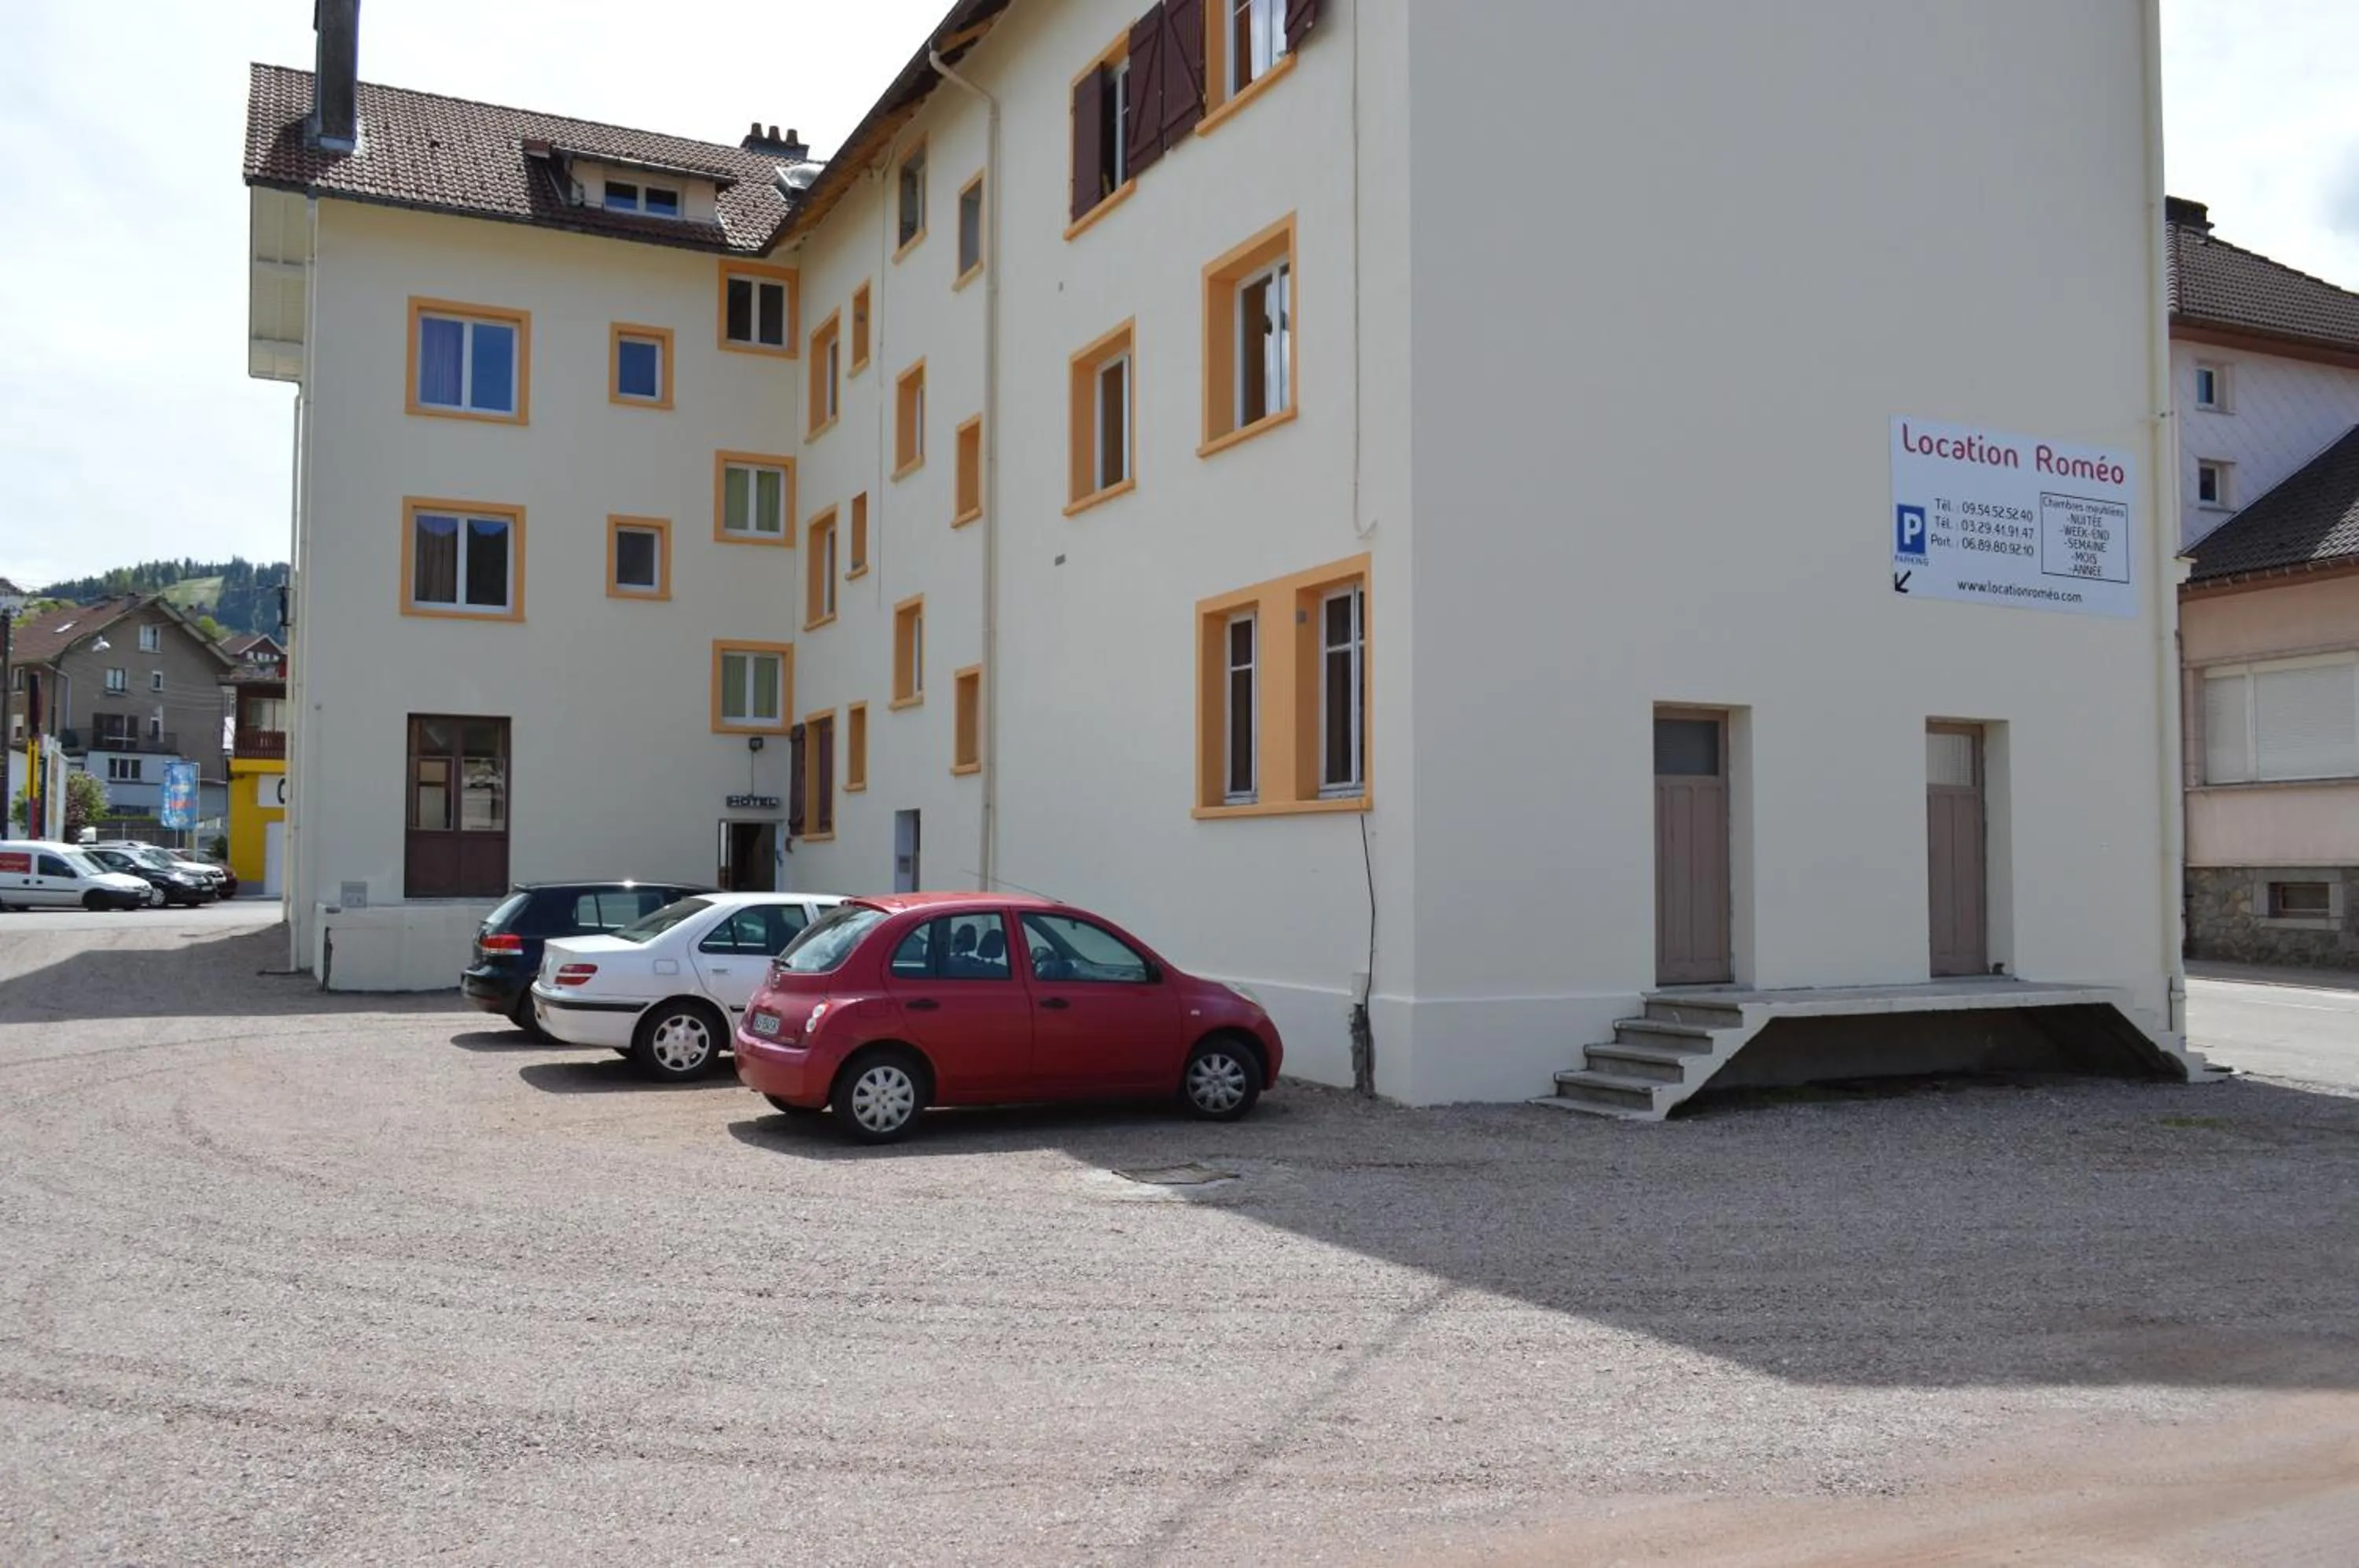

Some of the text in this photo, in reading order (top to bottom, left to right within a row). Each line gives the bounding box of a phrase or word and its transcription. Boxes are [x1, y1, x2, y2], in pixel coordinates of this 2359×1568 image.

[1901, 422, 2125, 485] Location Roméo
[1903, 512, 1923, 546] P
[1893, 554, 1930, 567] PARKING
